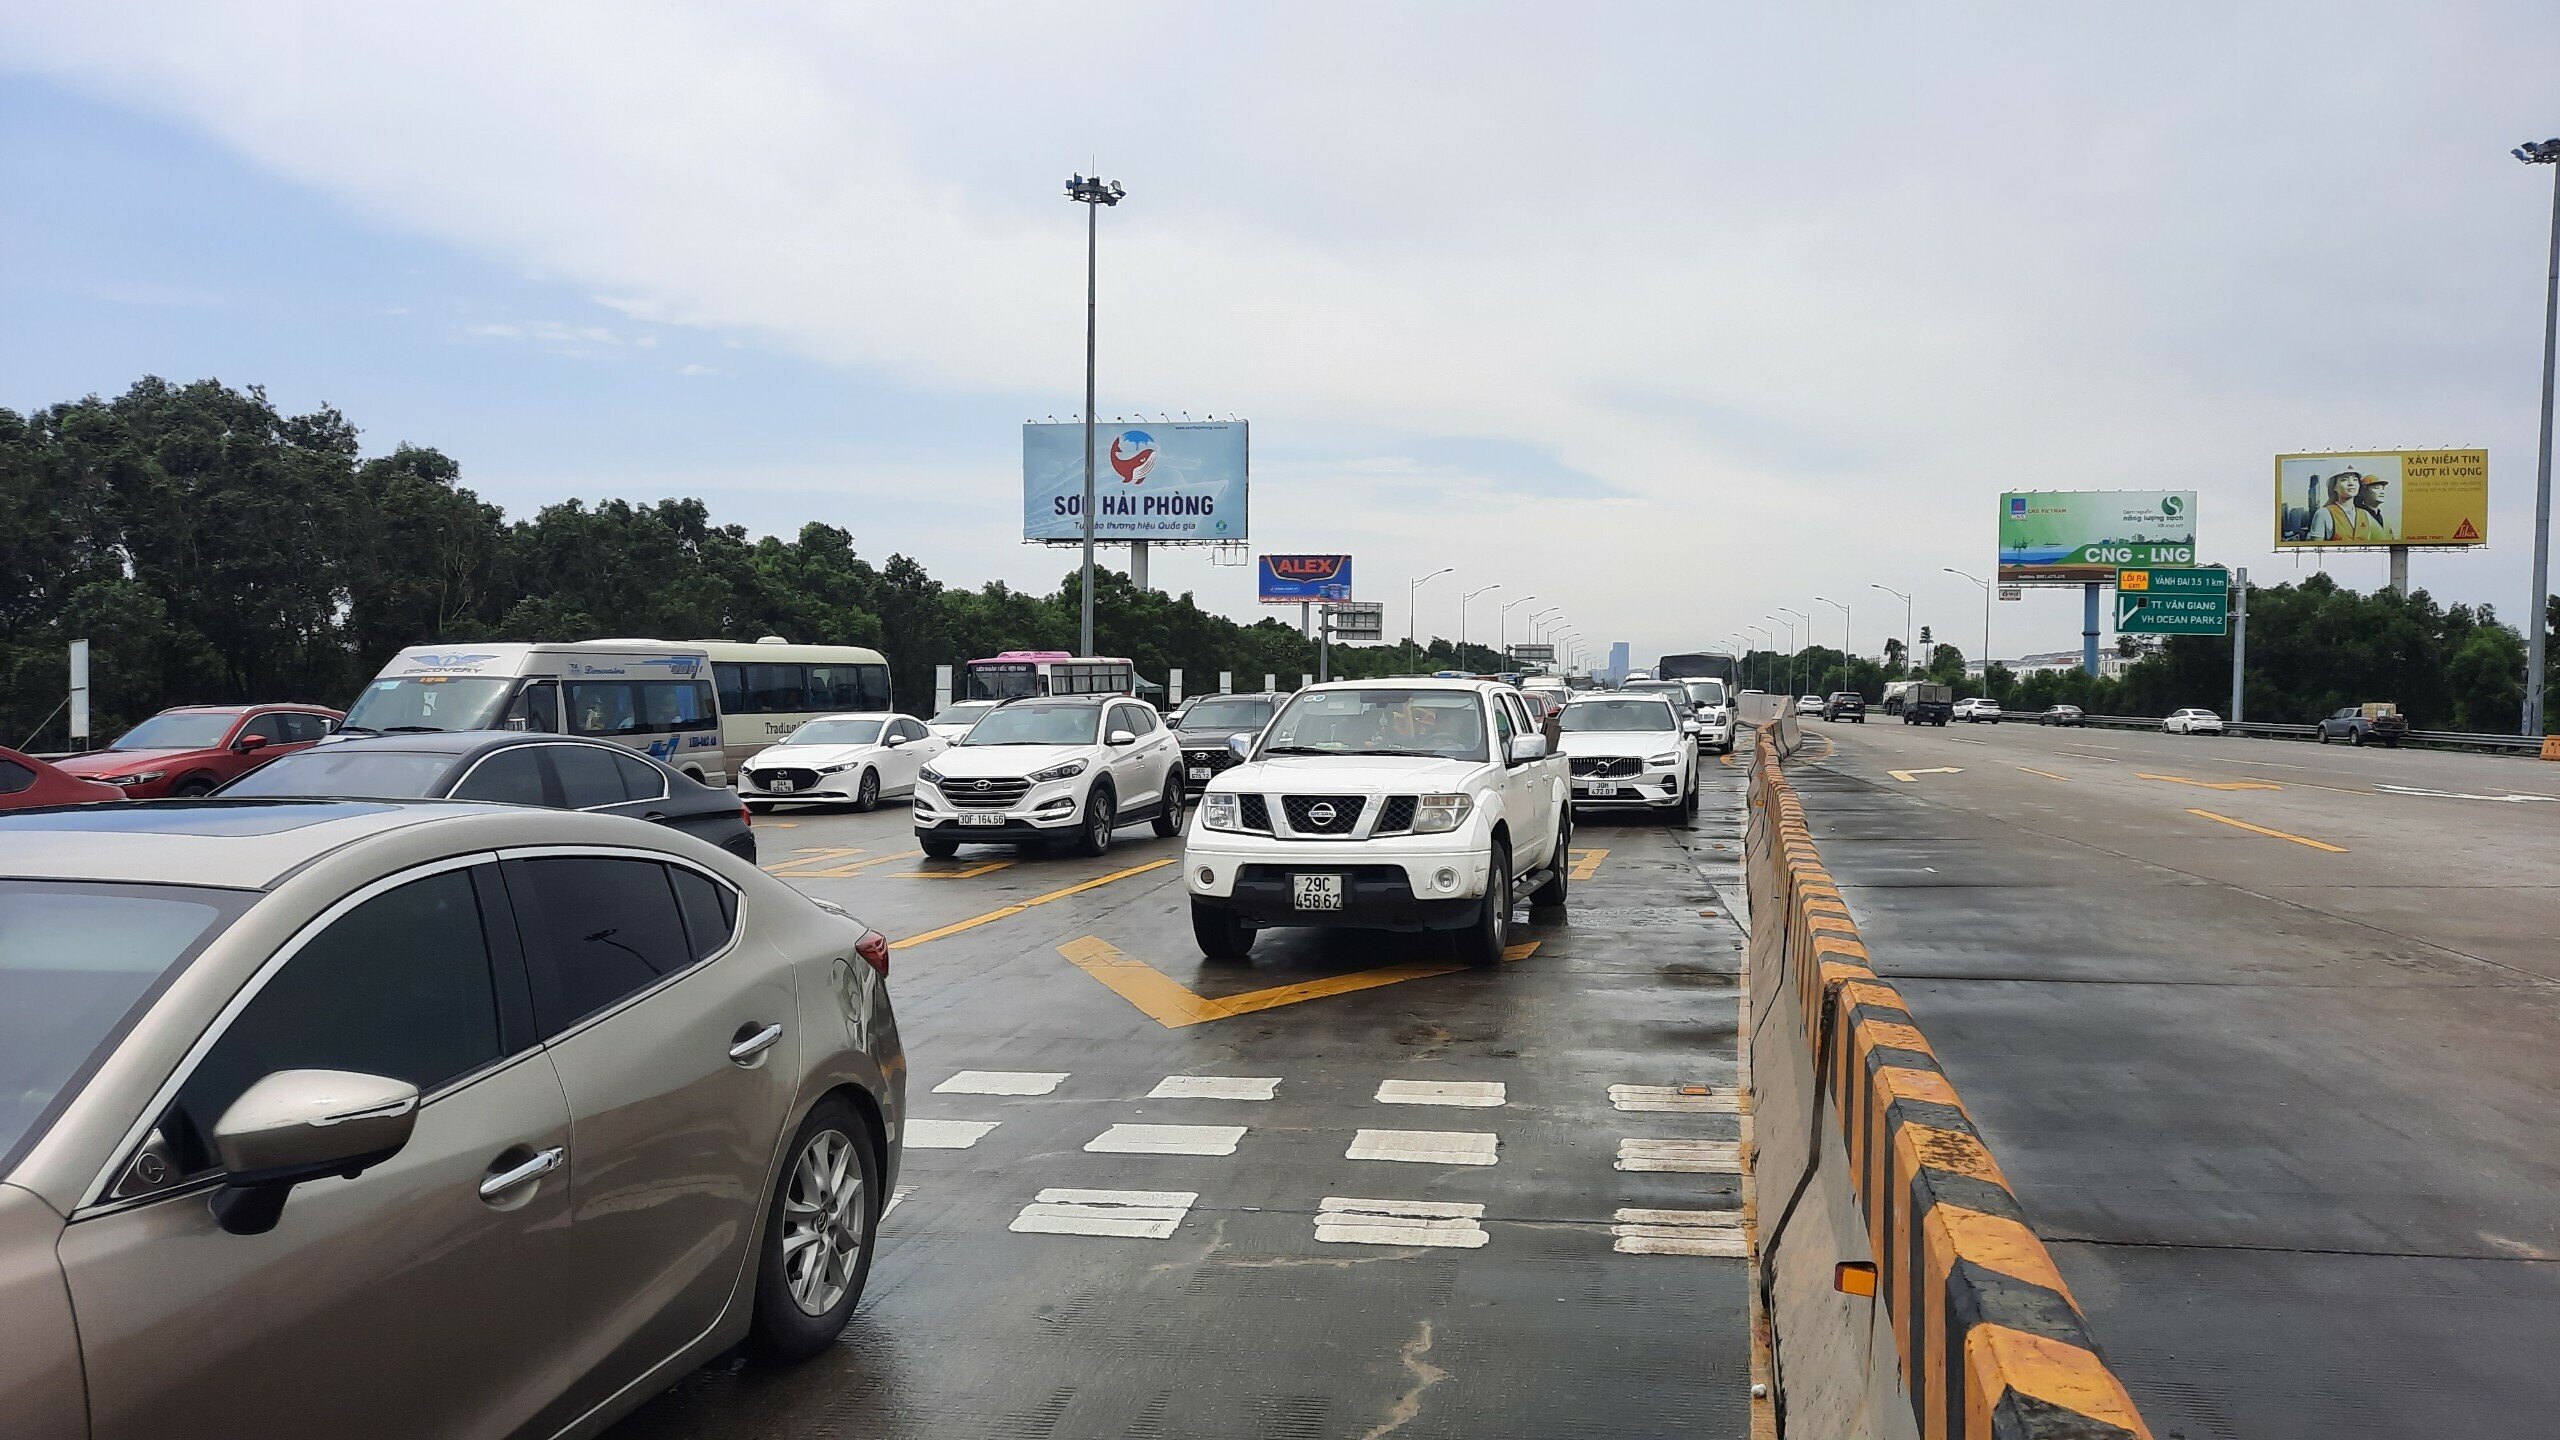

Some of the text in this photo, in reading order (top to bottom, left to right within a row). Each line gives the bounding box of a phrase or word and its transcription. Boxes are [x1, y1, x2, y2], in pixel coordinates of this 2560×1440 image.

[2461, 455, 2480, 464] TIN
[2407, 467, 2437, 478] VƯỢT
[2452, 466, 2482, 478] VỌNG
[1102, 490, 1136, 516] HẢI
[1143, 491, 1214, 516] PHÒNG
[1137, 522, 1156, 531] hiệu
[1183, 523, 1196, 532] gia
[2084, 547, 2133, 563] CNG
[2150, 547, 2191, 563] LNG
[1277, 558, 1334, 574] ALEX
[2177, 577, 2190, 586] ĐAI
[2191, 577, 2203, 586] 3.5
[2211, 578, 2225, 587] km
[2187, 601, 2217, 611] GIANG
[2141, 615, 2223, 625] VH OCEAN PARK 2
[403, 667, 483, 675] DISCOVERY
[1305, 877, 1331, 892] 29C
[1295, 893, 1341, 910] 458.62
